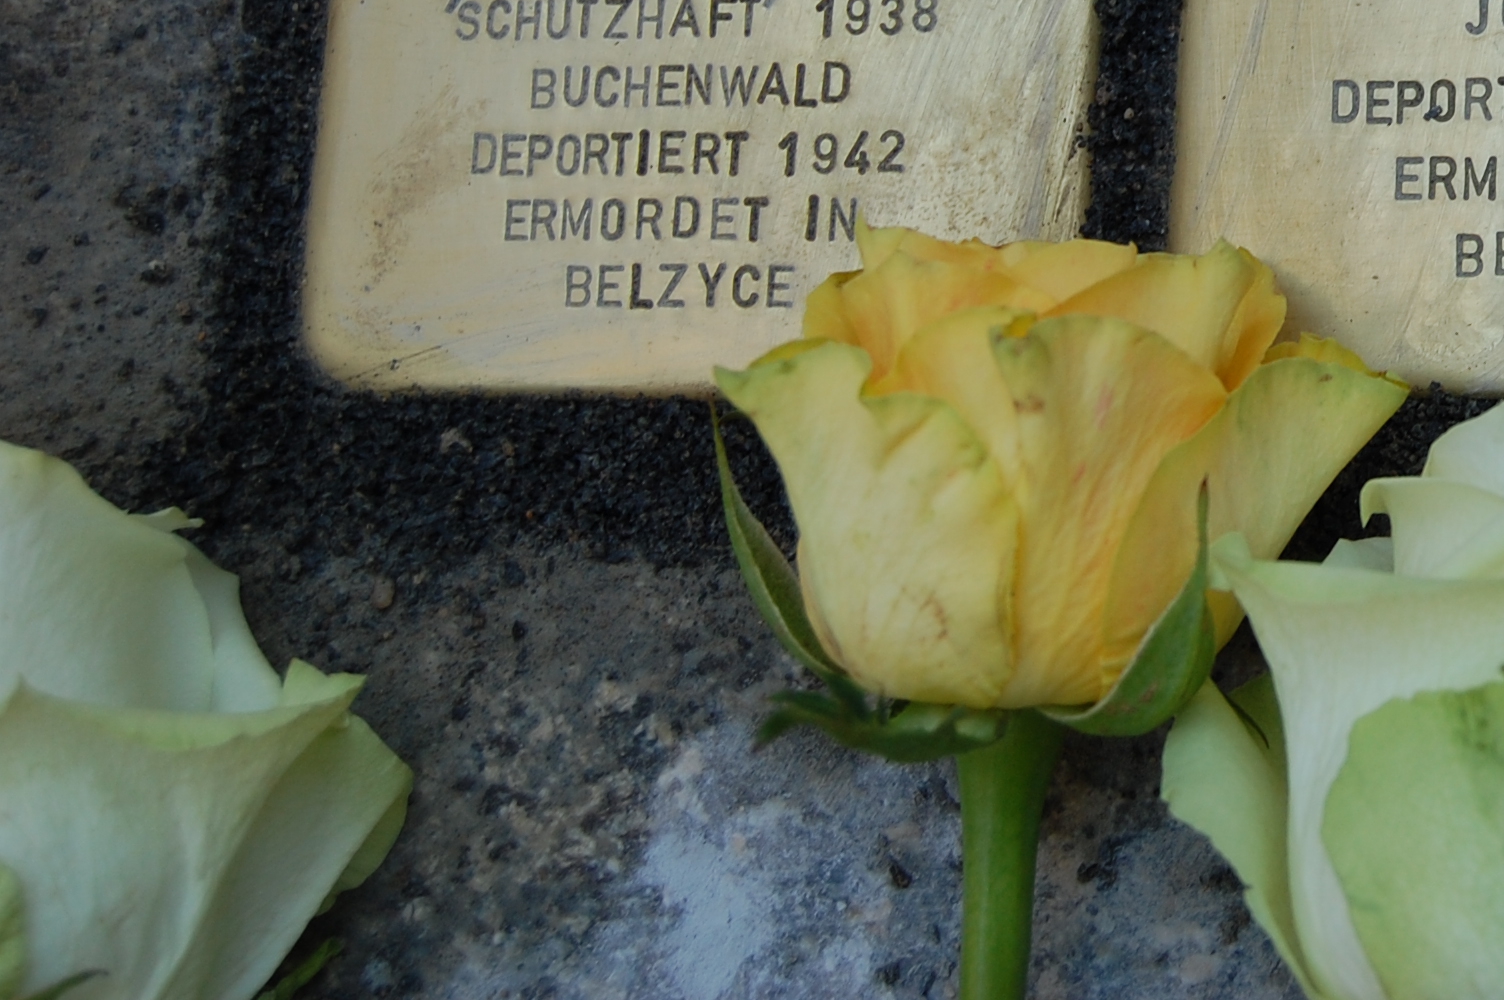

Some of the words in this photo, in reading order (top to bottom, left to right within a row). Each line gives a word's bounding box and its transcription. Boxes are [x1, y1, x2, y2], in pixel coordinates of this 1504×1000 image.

[530, 62, 853, 110] BUCHENWALD
[470, 129, 750, 177] DEPORTIERT
[778, 129, 906, 177] 1942
[503, 197, 770, 243] ERMORDET
[804, 195, 859, 243] IN
[564, 263, 796, 310] BELZYCE
